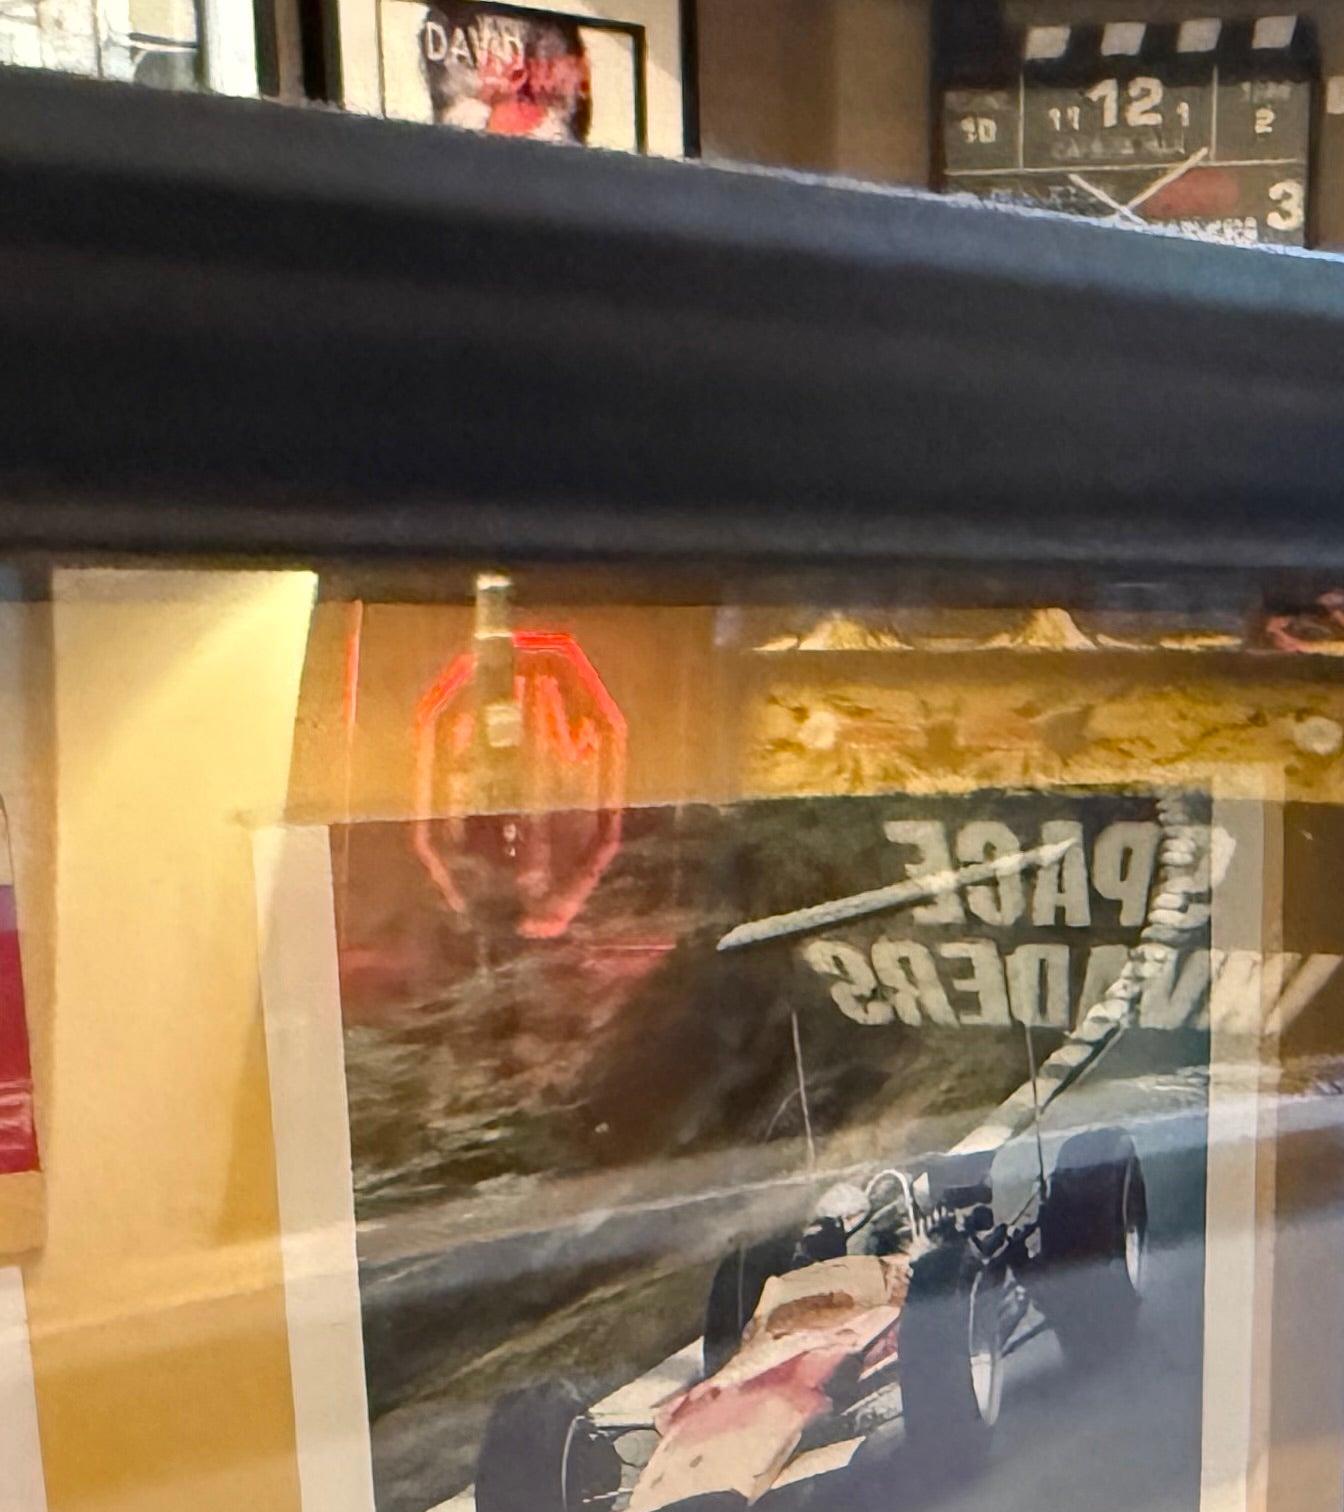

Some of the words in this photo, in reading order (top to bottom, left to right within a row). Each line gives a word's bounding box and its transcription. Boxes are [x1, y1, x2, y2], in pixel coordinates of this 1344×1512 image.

[1085, 76, 1163, 128] 12
[1255, 106, 1276, 133] 2
[1267, 179, 1303, 231] 3
